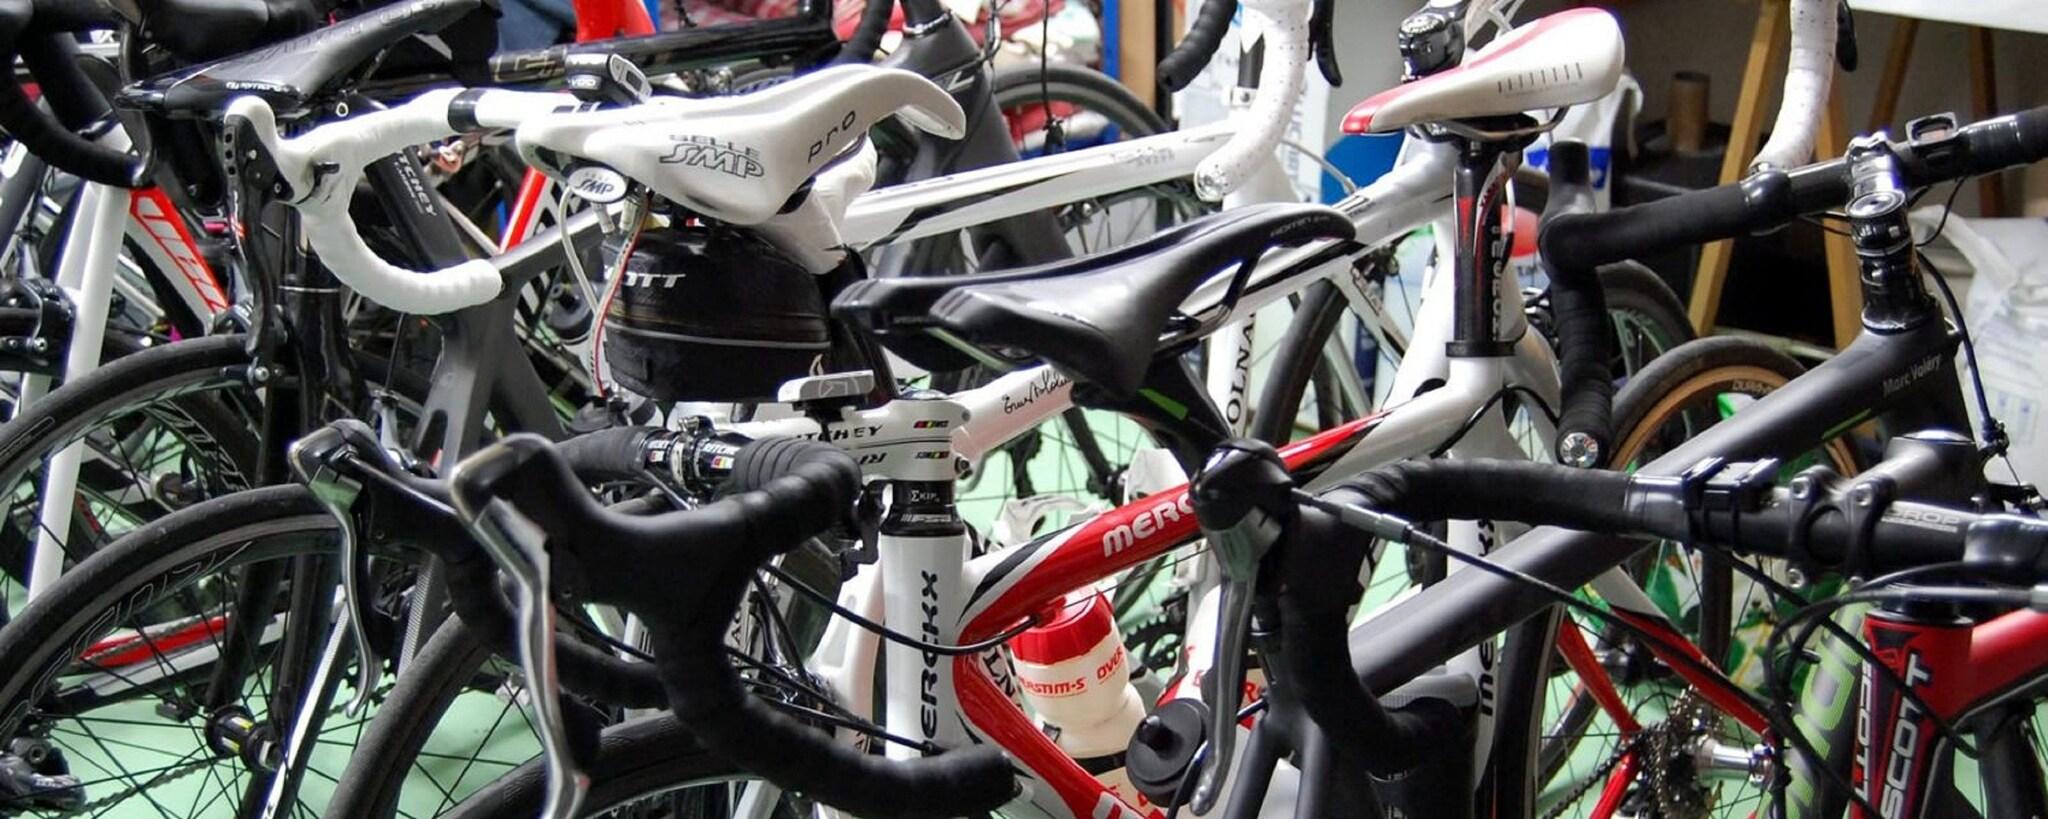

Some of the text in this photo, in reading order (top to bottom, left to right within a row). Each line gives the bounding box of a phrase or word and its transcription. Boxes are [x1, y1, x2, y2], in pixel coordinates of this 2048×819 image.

[659, 143, 765, 178] SMP
[807, 110, 856, 164] pro
[398, 154, 438, 216] TCHEY
[574, 179, 615, 195] SMP
[1227, 314, 1255, 435] OLNA
[1103, 492, 1195, 558] MERC
[920, 570, 939, 755] ERCKX
